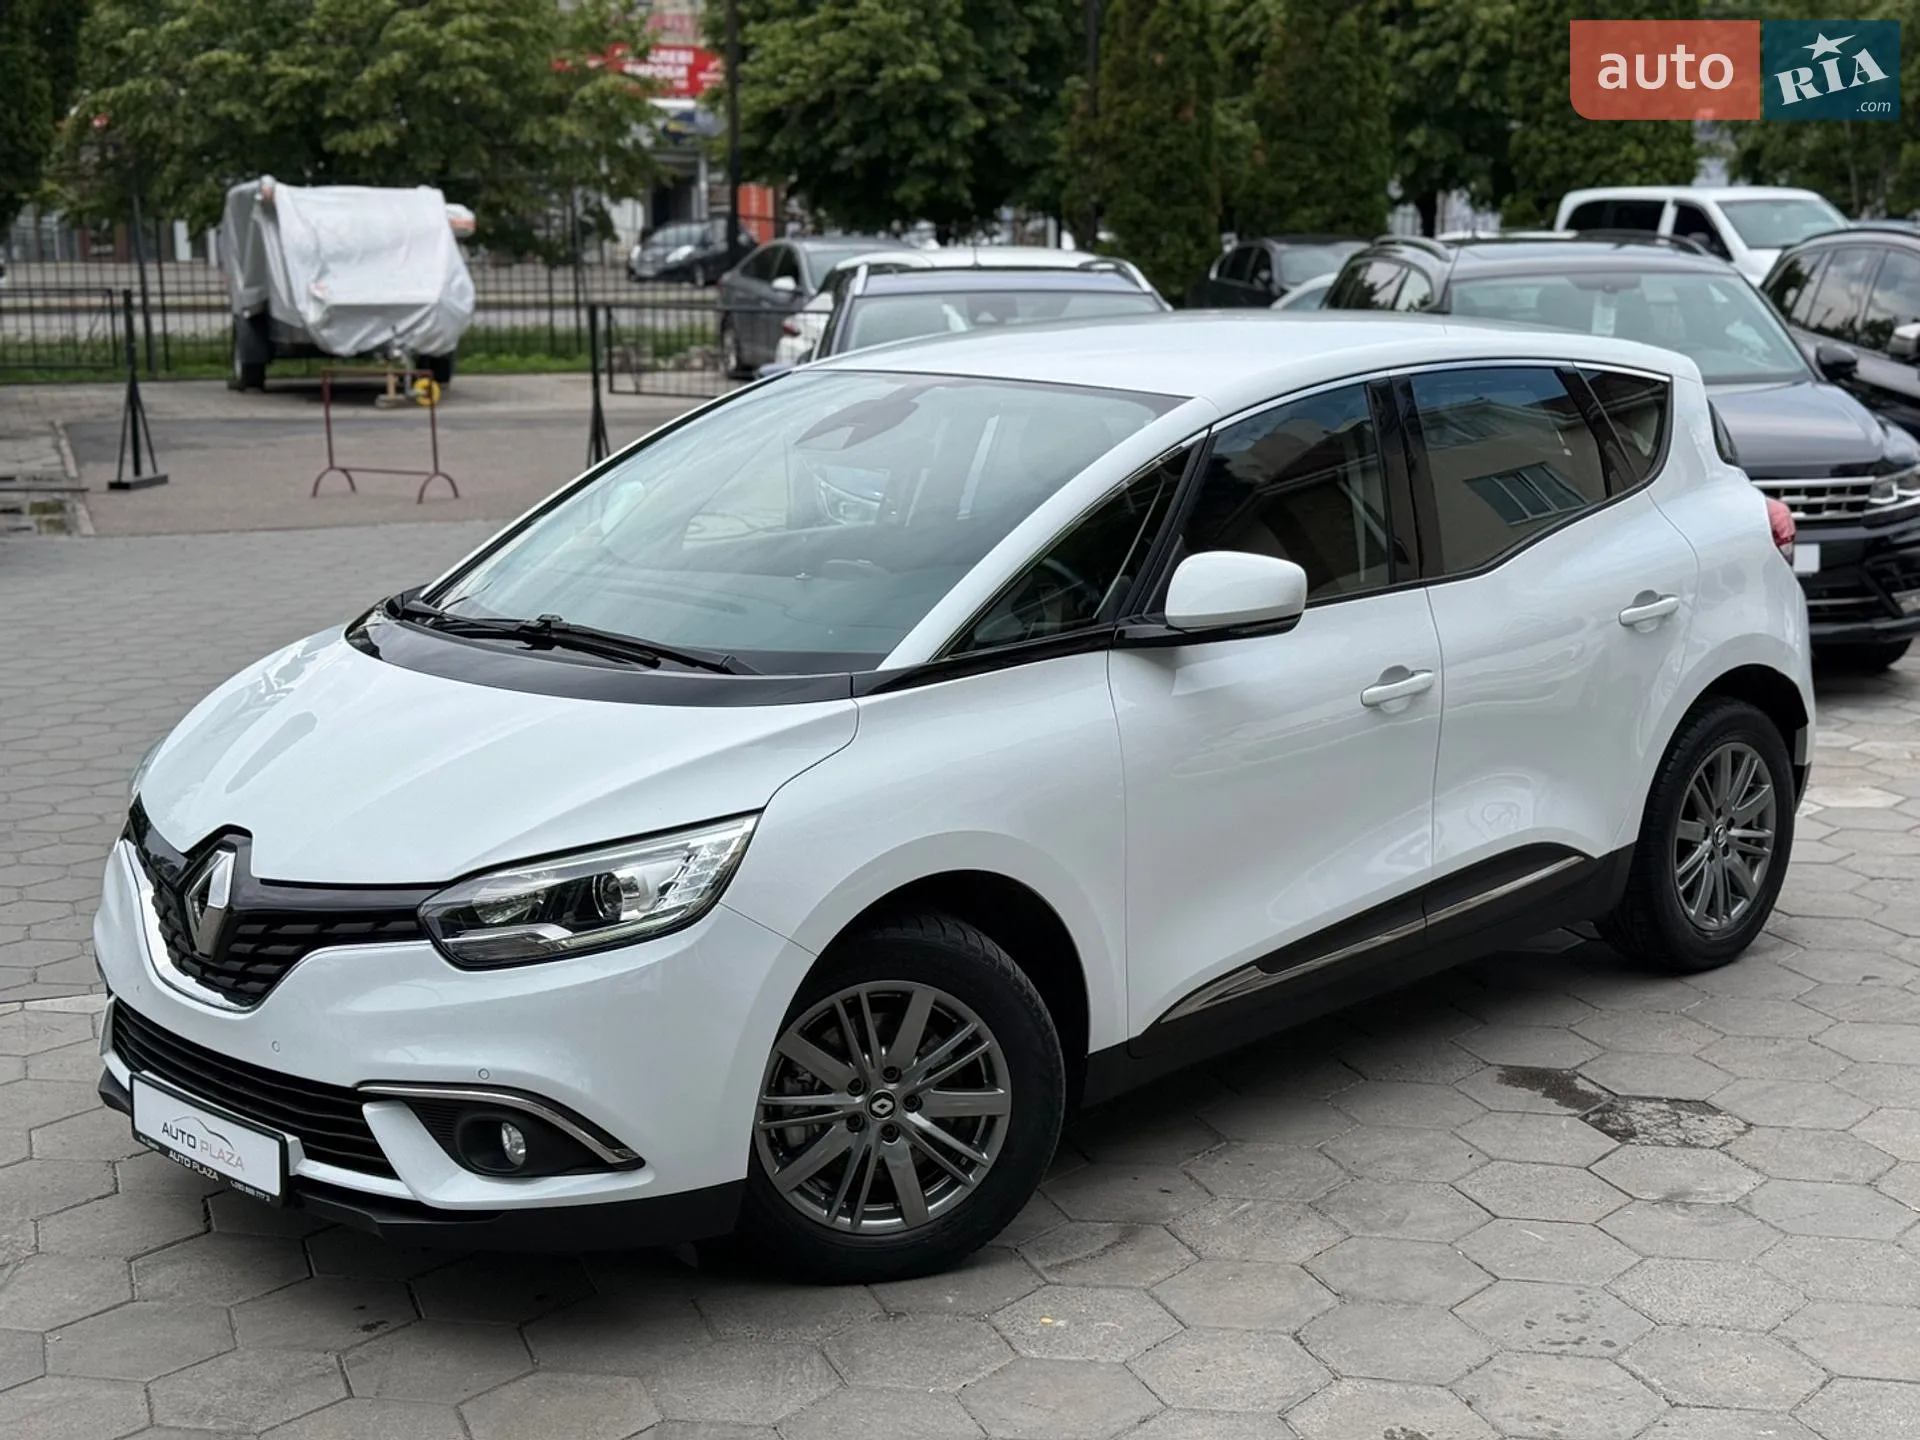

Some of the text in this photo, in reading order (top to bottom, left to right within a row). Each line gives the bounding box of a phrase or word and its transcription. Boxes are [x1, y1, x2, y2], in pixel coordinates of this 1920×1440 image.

[161, 1121, 197, 1149] AUTO
[200, 1140, 244, 1172] PLAZA
[168, 1150, 219, 1181] AUTO PLAZA
